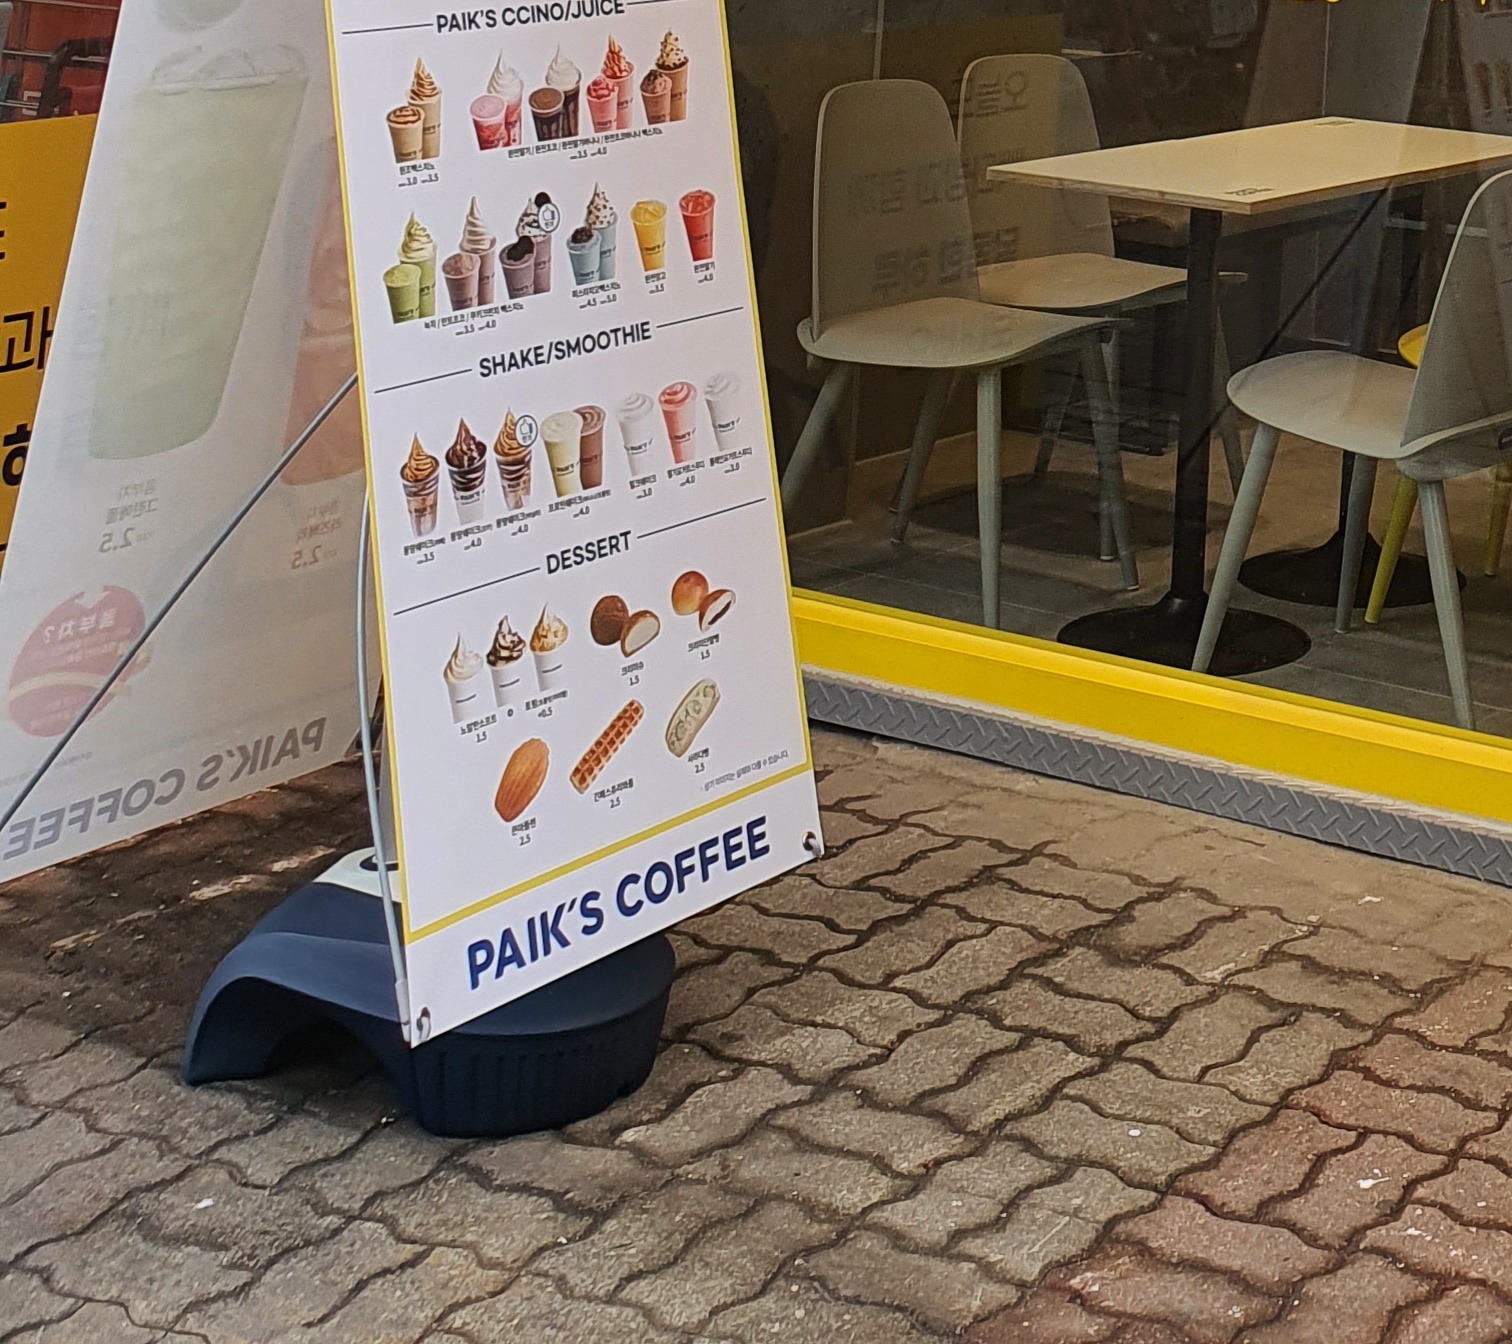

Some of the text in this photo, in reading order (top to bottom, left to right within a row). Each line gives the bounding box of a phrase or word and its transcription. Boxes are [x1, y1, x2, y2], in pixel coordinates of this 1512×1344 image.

[436, 8, 498, 34] PAIK'S
[479, 320, 652, 379] SHAKE/SMOOTHIE
[545, 530, 632, 575] DESSERT
[467, 814, 771, 991] PAIK'S COFFEE
